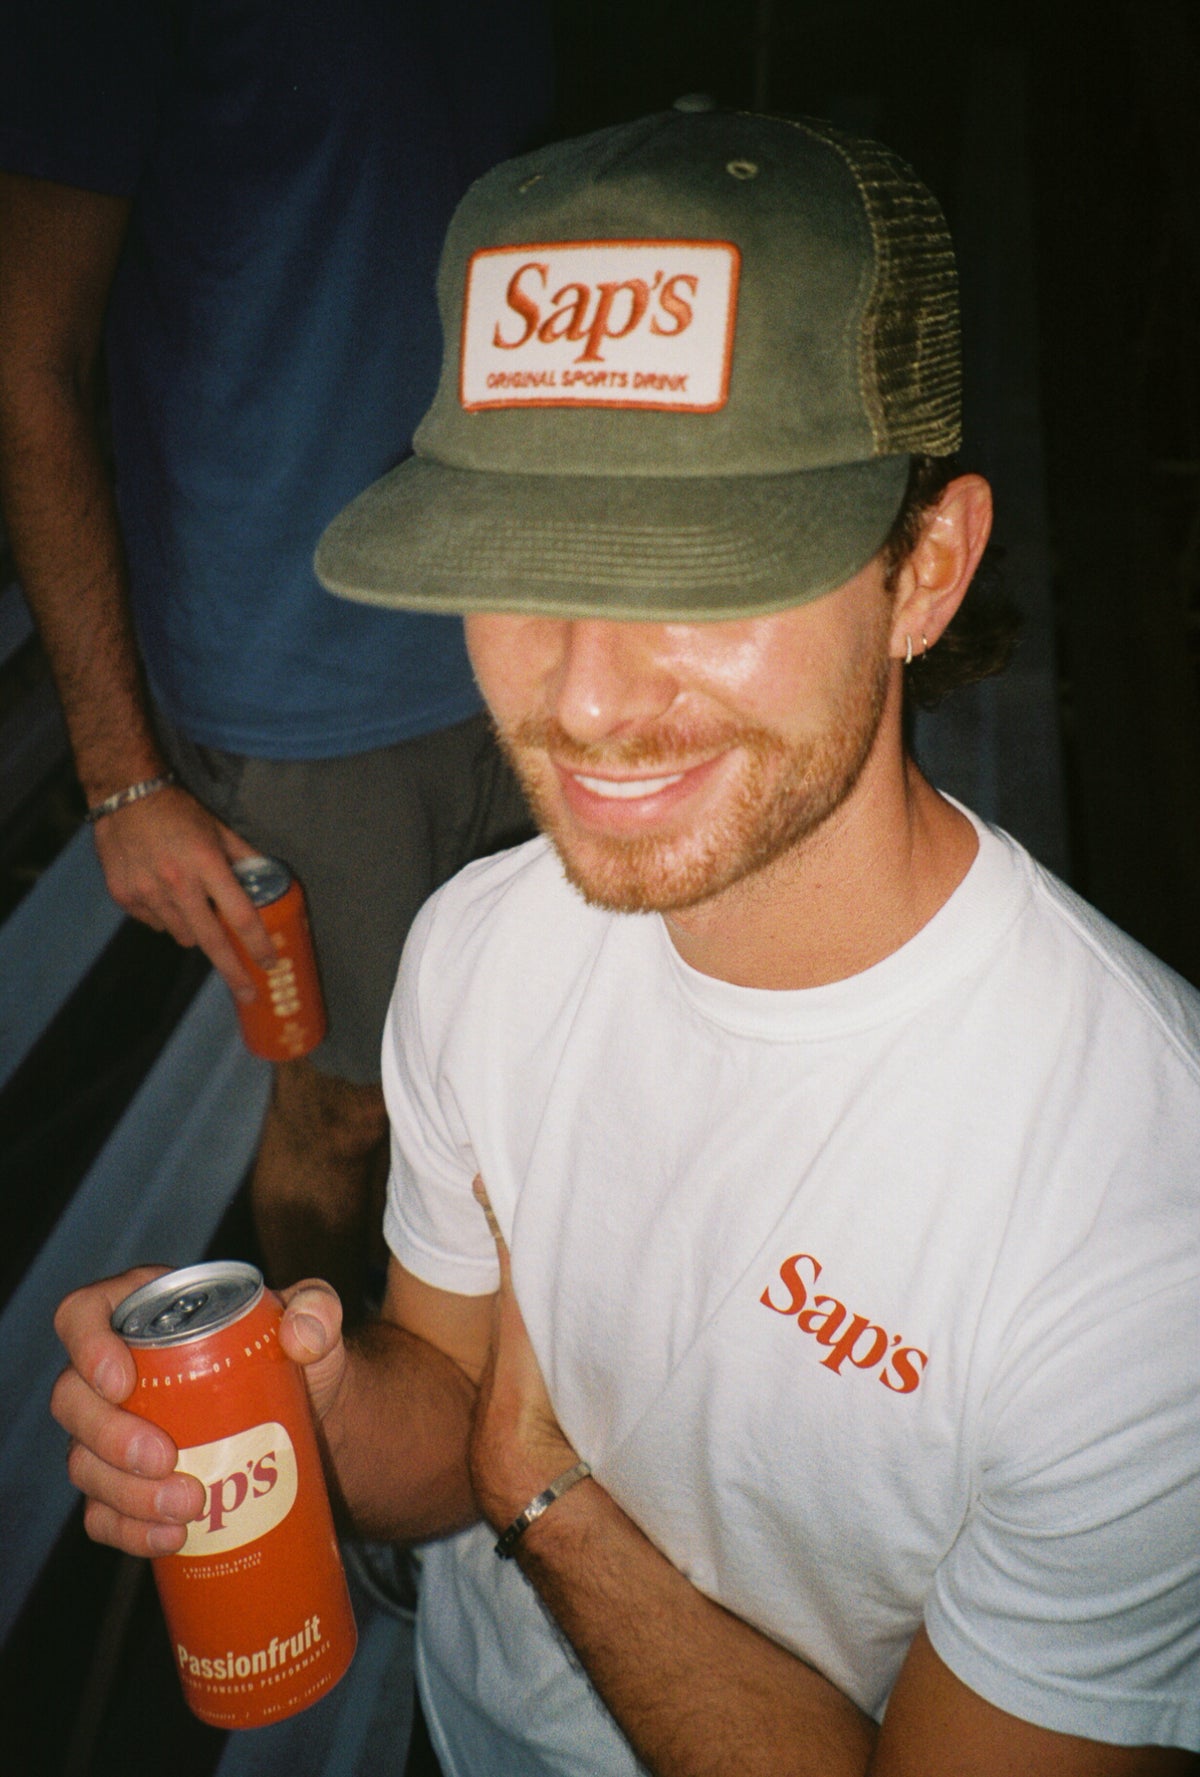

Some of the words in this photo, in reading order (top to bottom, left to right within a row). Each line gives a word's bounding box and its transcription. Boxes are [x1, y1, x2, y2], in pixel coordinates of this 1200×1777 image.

[492, 262, 699, 364] Sap's
[486, 370, 556, 389] ORIGINAL
[561, 370, 629, 388] SPORTS
[632, 371, 688, 392] DRINK
[759, 1253, 929, 1394] Sap's
[141, 1371, 197, 1388] ENGTH
[177, 1614, 321, 1680] Passionfruit
